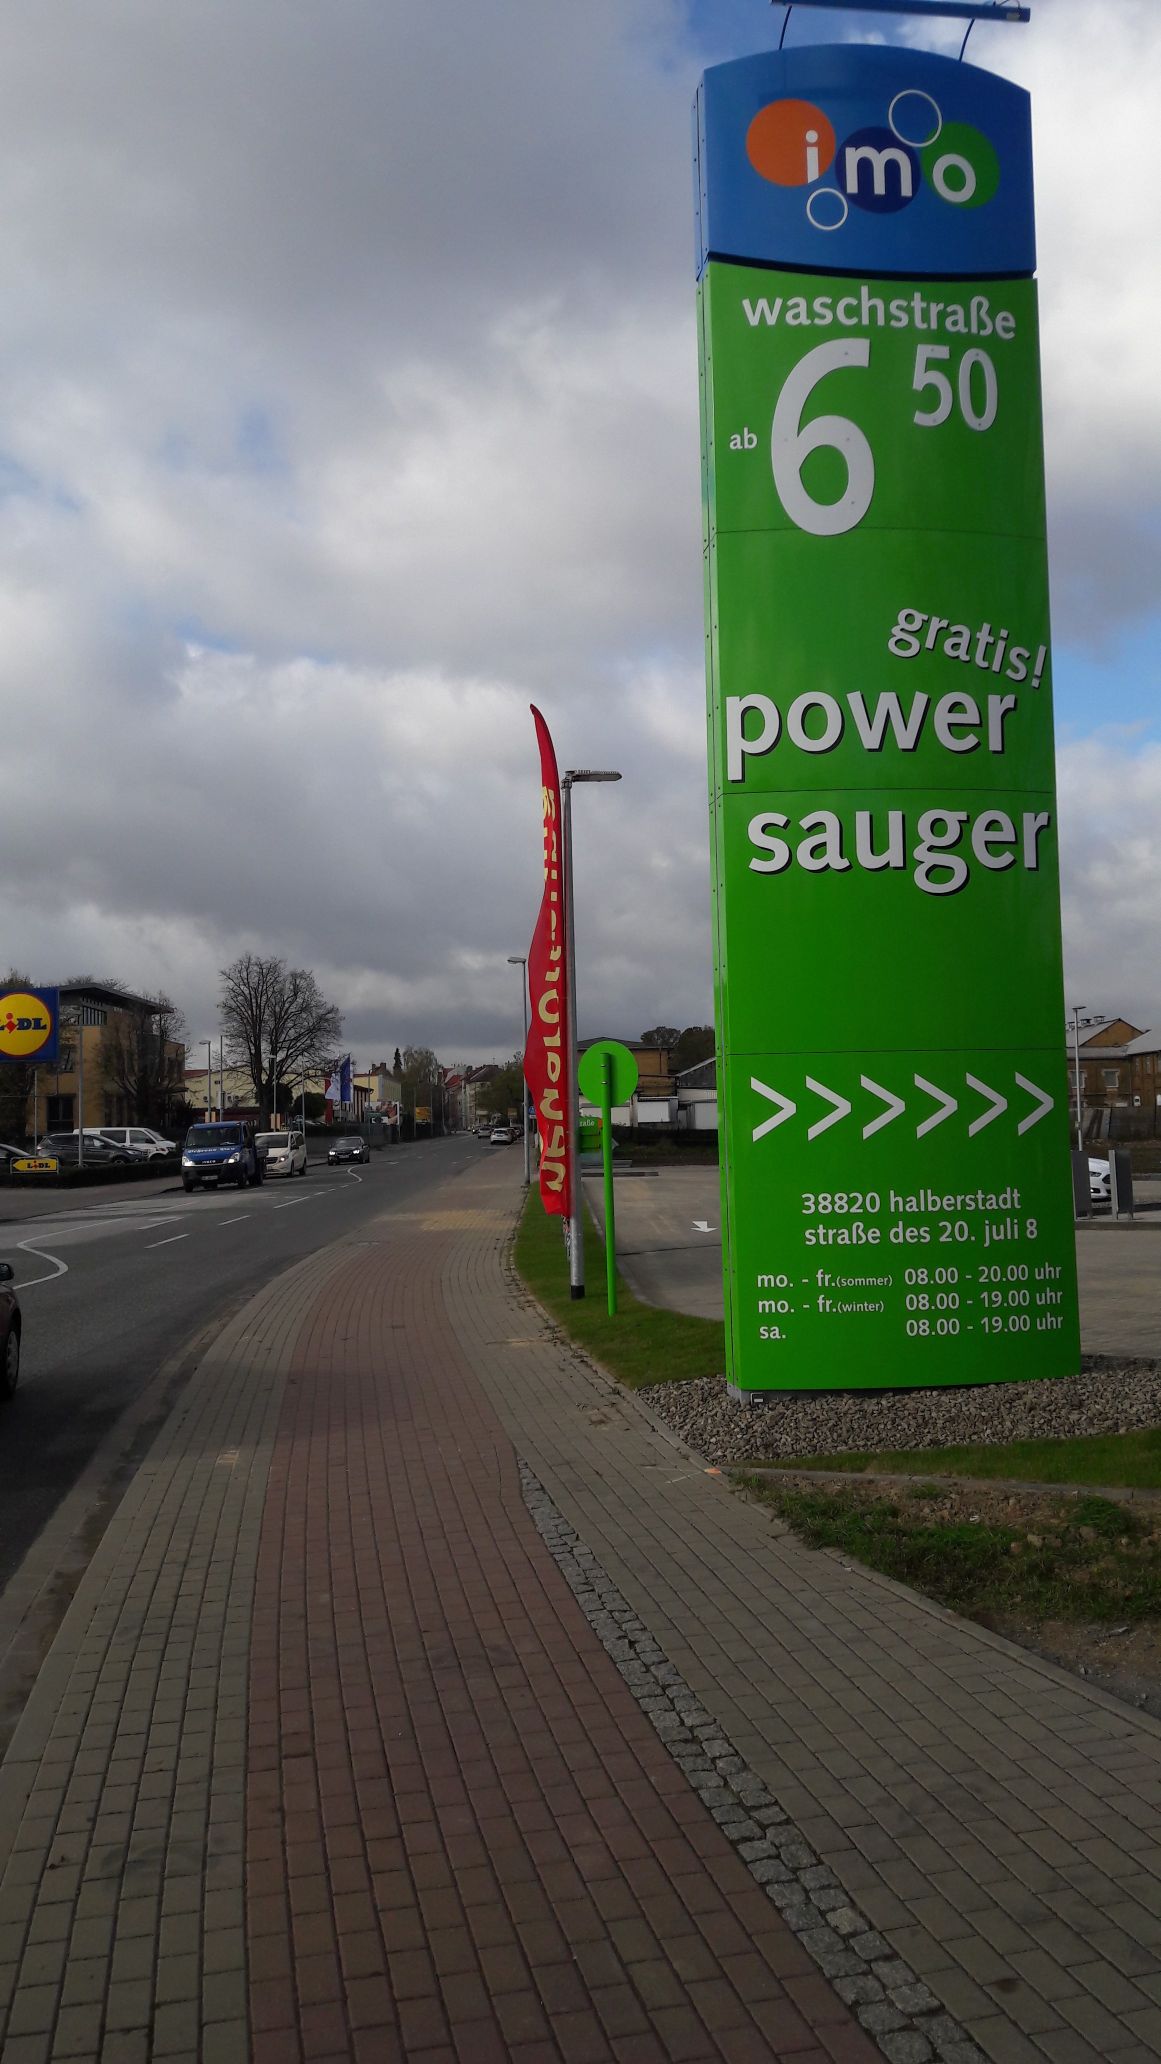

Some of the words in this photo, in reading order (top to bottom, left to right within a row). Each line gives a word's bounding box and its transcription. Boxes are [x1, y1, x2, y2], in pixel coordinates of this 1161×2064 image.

[805, 129, 977, 204] imo
[741, 285, 1016, 340] waschstraße
[729, 426, 758, 450] ab
[770, 337, 875, 536] 6
[912, 343, 998, 432] 50
[887, 608, 1047, 689] gratis!
[725, 690, 1016, 783] power
[747, 808, 1049, 894] sauger
[801, 1191, 881, 1215] 38820
[889, 1186, 1021, 1213] halberstadt
[804, 1221, 881, 1246] straße
[889, 1220, 931, 1244] des
[938, 1220, 976, 1242] 20.
[983, 1217, 1019, 1247] juli
[1026, 1218, 1038, 1240] 8
[757, 1274, 794, 1288] mo.
[904, 1267, 959, 1285] 08.00
[978, 1264, 1029, 1283] 20.00
[1034, 1262, 1062, 1281] uhr
[758, 1299, 795, 1314] mo.
[905, 1292, 960, 1311] 08.00
[980, 1289, 1030, 1308] 19.00
[1035, 1287, 1063, 1306] uhr
[759, 1325, 787, 1340] sa.
[906, 1318, 960, 1337] 08.00
[980, 1314, 1031, 1334] 19.00
[1036, 1311, 1064, 1331] uhr
